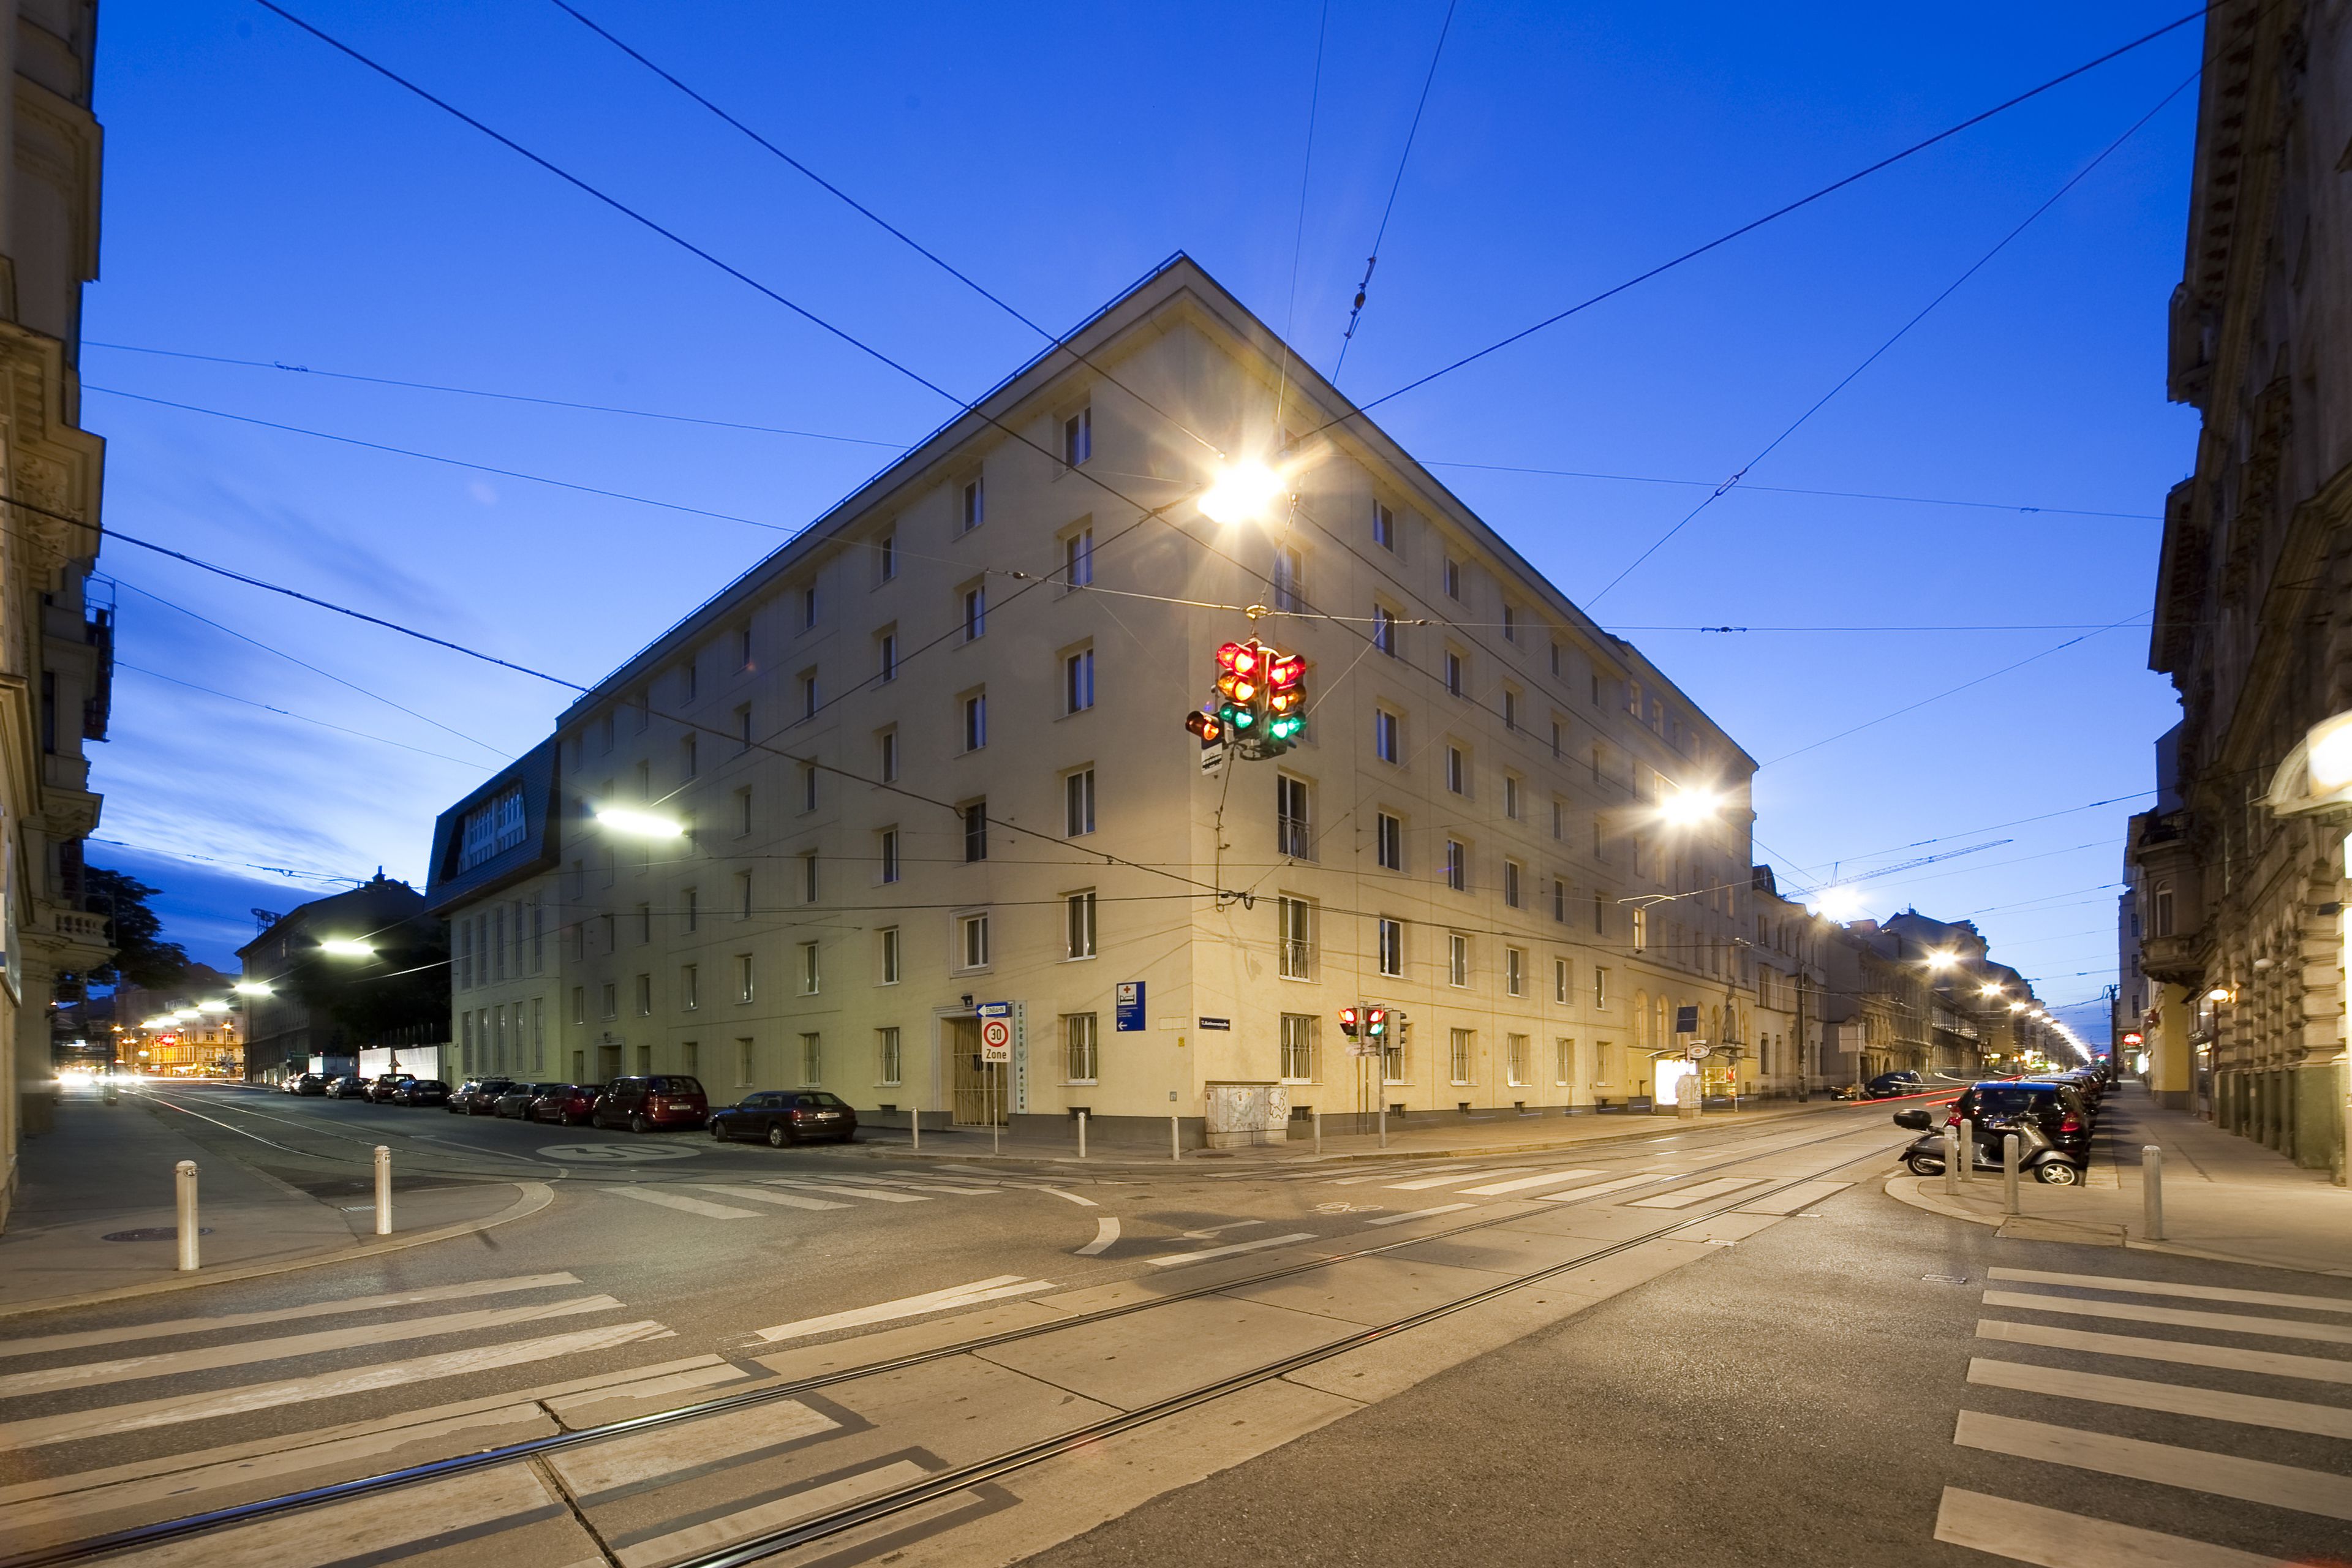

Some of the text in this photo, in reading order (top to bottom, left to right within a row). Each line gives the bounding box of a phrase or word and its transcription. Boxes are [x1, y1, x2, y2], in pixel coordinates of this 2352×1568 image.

[991, 1028, 1001, 1040] 30
[986, 1049, 1006, 1059] Zone
[553, 1145, 676, 1158] 30
